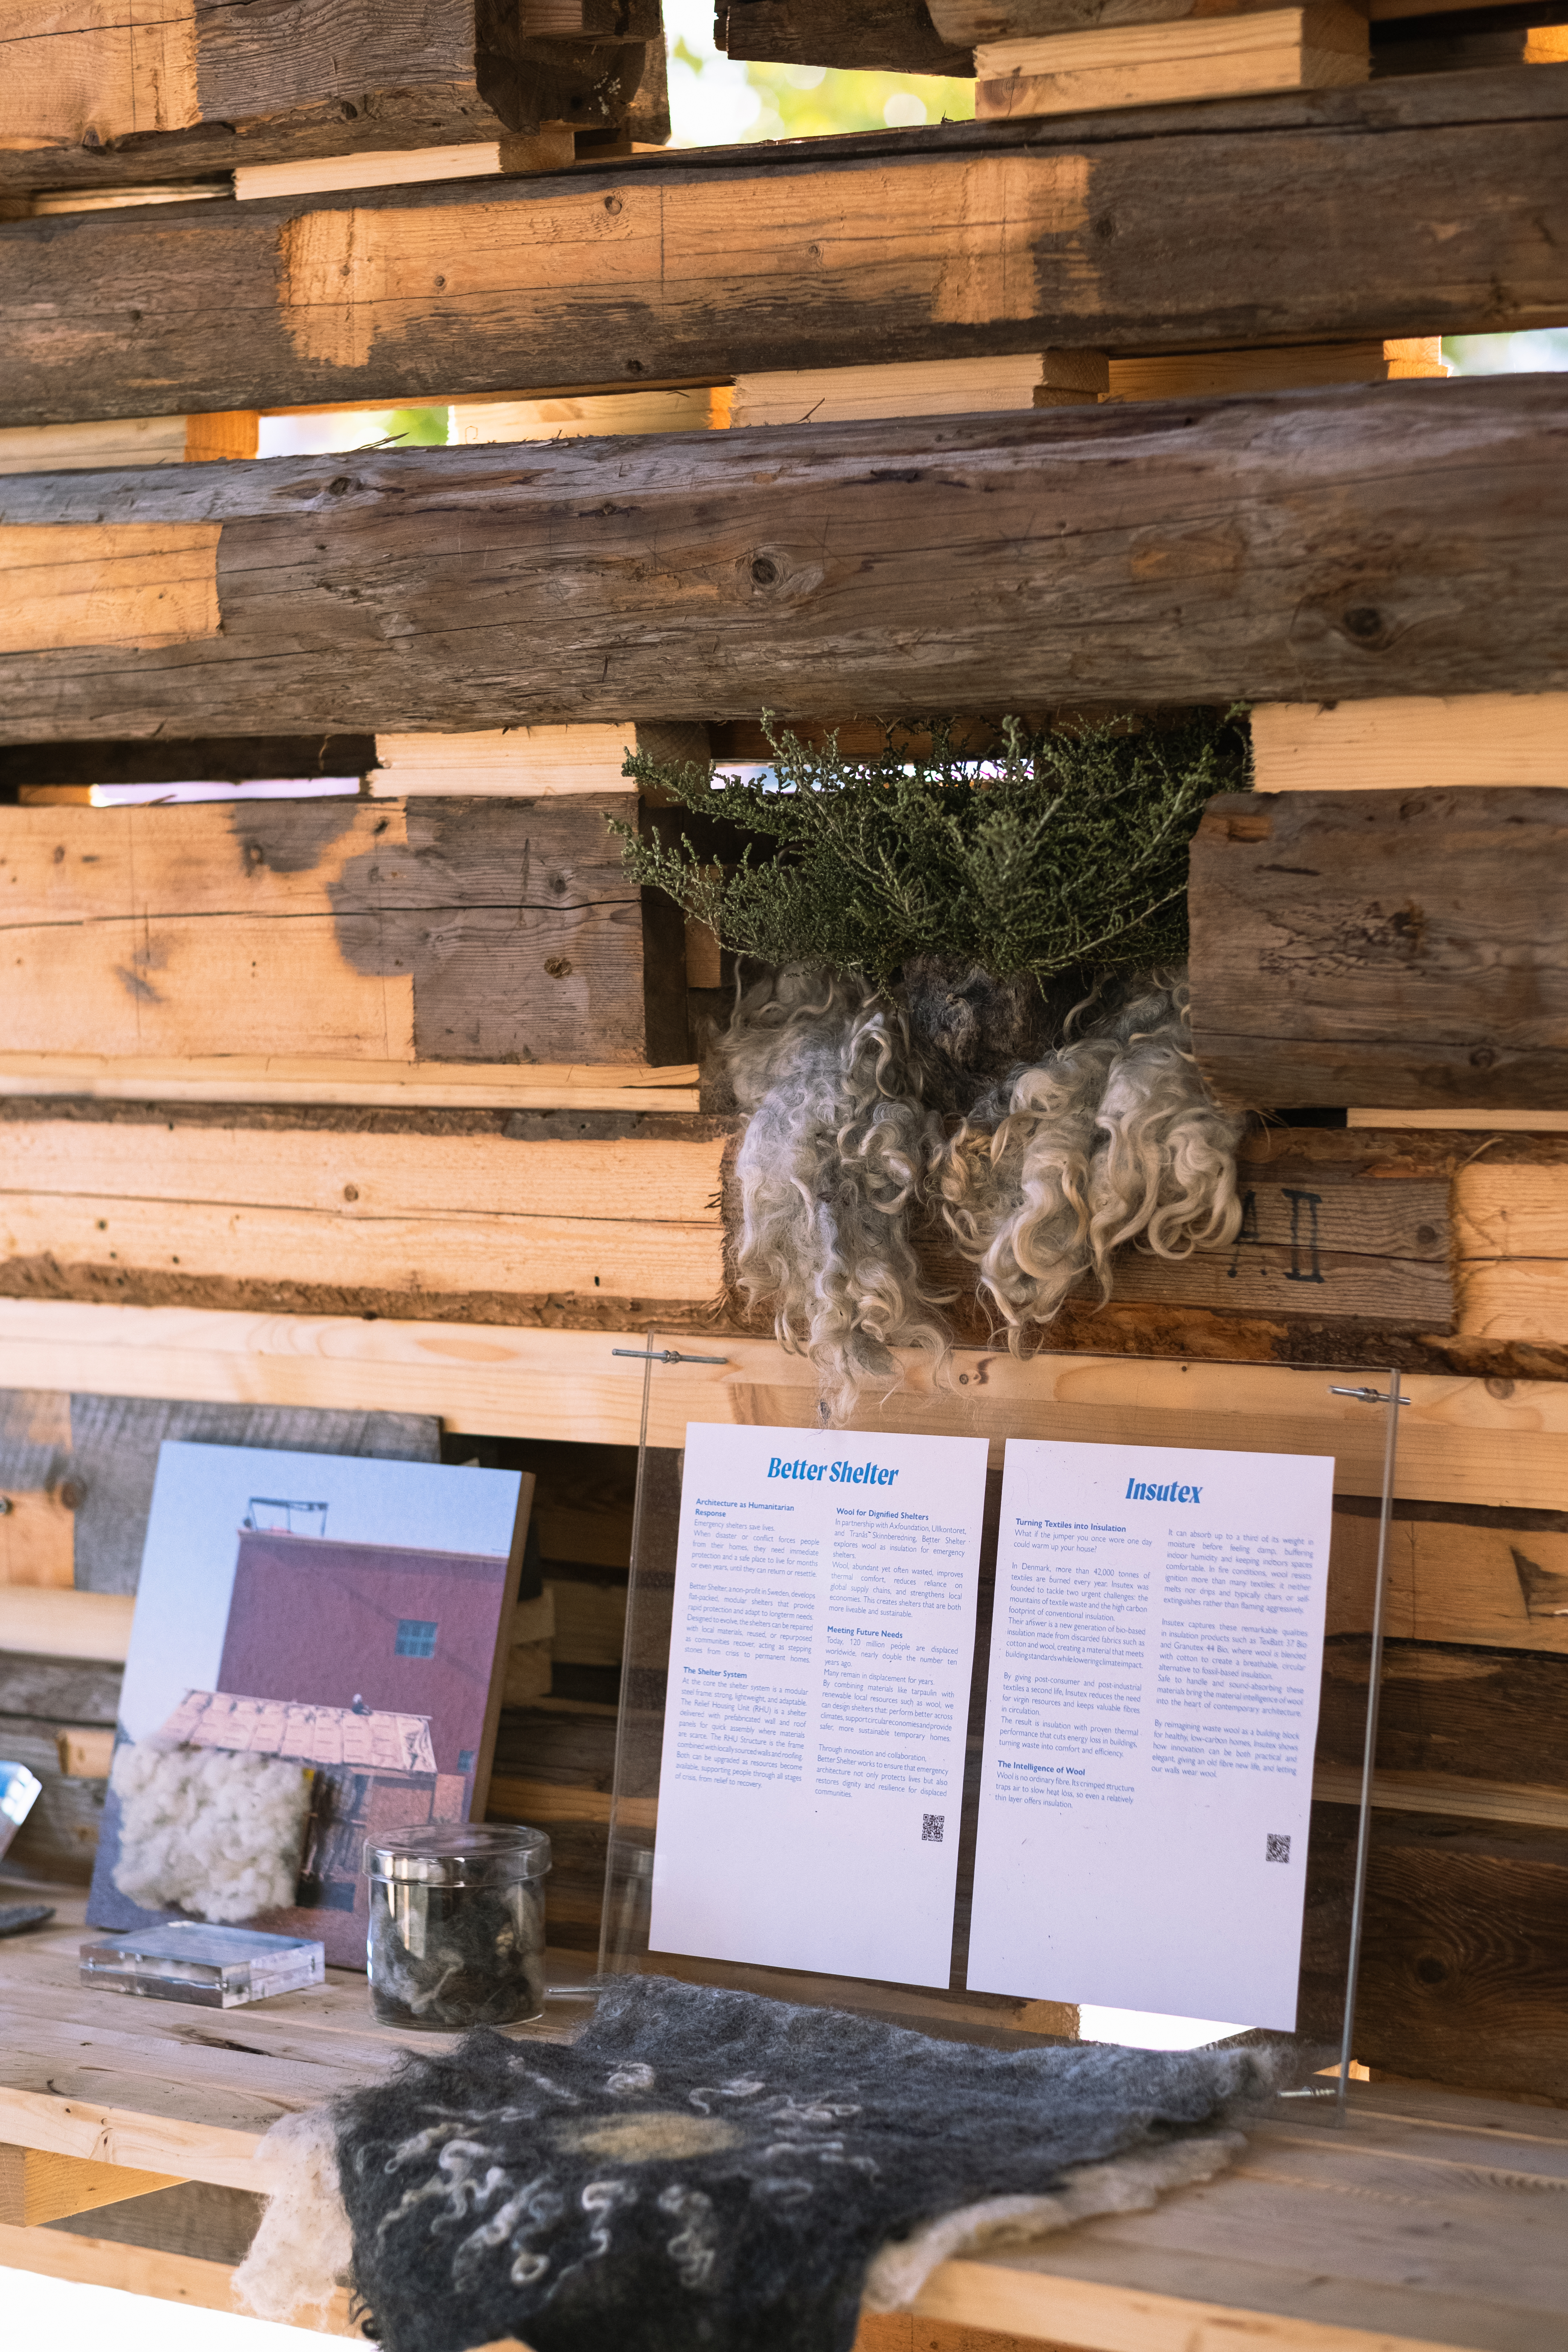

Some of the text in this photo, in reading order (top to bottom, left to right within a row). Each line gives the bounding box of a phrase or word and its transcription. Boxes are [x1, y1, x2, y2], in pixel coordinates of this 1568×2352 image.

[767, 1457, 899, 1485] Better Shelter
[1125, 1478, 1203, 1504] Insutex
[696, 1498, 738, 1507] Architecture
[748, 1502, 794, 1511] Humanitarian
[695, 1508, 726, 1517] Response
[868, 1510, 899, 1519] Dignified
[842, 1520, 874, 1529] partnership
[1016, 1518, 1043, 1528] Turning
[1044, 1520, 1072, 1528] Textiles
[1091, 1523, 1126, 1532] Insulation
[1053, 1532, 1075, 1542] jumper
[1142, 1538, 1152, 1547] day
[834, 1540, 858, 1549] explores
[933, 1549, 965, 1557] emergency
[852, 1563, 879, 1571] abundant
[937, 1570, 963, 1578] improves
[1093, 1568, 1114, 1576] 42,000
[1049, 1575, 1070, 1584] burned
[1112, 1580, 1133, 1589] Insutex
[846, 1605, 867, 1614] liveable
[899, 1599, 921, 1607] shelters
[1009, 1606, 1035, 1616] footprint
[827, 1626, 903, 1638] Meeting Future Needs
[891, 1642, 910, 1652] people
[931, 1645, 958, 1655] displaced
[861, 1651, 878, 1660] nearly
[698, 1668, 721, 1676] Shelter
[723, 1670, 747, 1679] System
[1000, 1728, 1038, 1738] performance
[1067, 1735, 1088, 1744] energy
[1014, 1762, 1054, 1773] Intelligence
[1066, 1767, 1085, 1775] Wool
[842, 1779, 861, 1789] dignity
[920, 1787, 947, 1797] displaced
[1008, 1795, 1023, 1804] layer
